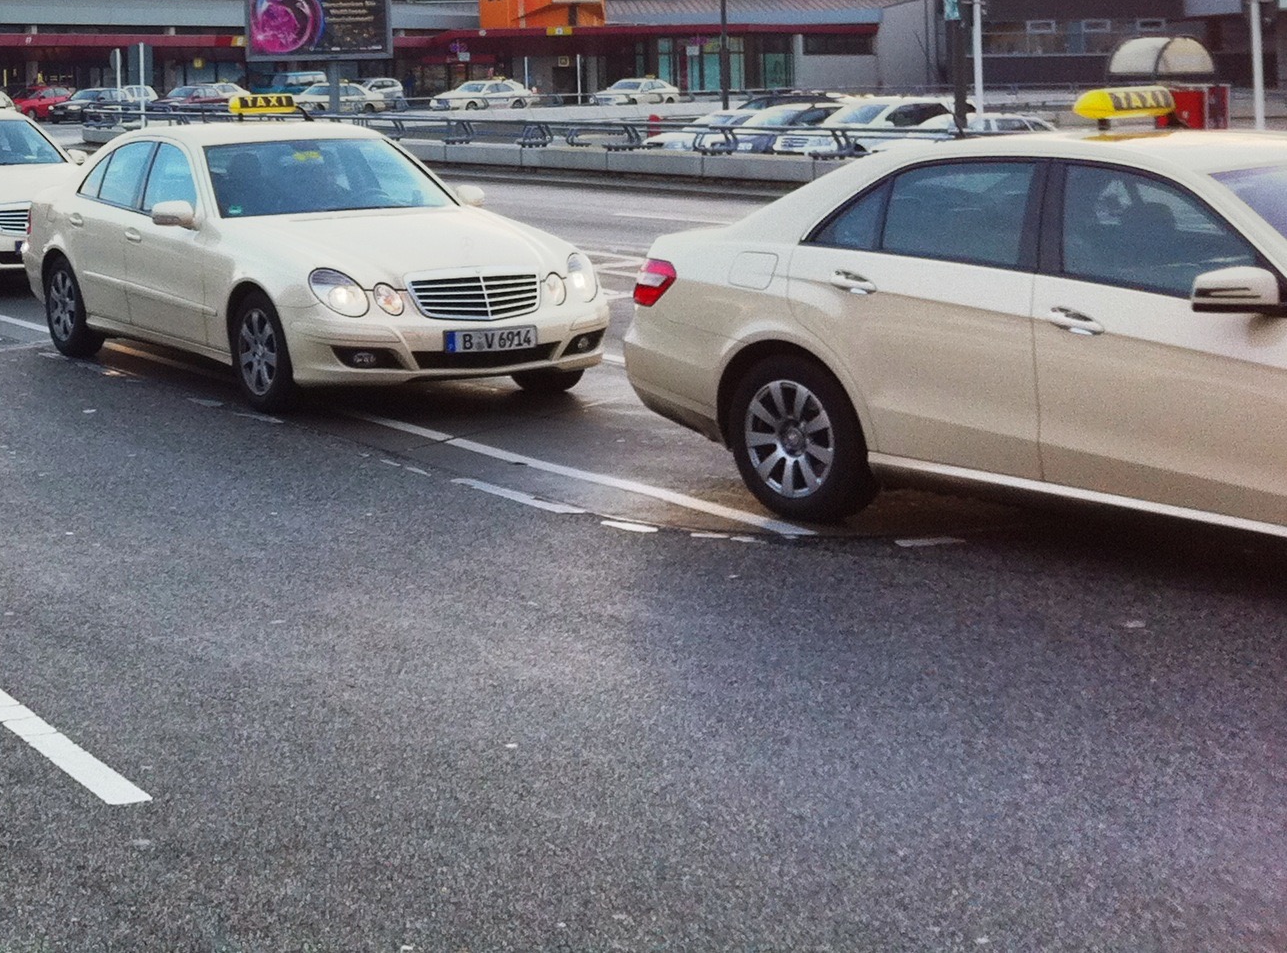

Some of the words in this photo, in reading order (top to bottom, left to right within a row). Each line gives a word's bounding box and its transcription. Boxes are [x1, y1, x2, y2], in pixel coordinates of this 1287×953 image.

[244, 97, 287, 107] TAXI
[1114, 91, 1166, 108] TAXI
[463, 333, 473, 350] B
[484, 332, 495, 349] V
[498, 329, 532, 349] 6914
